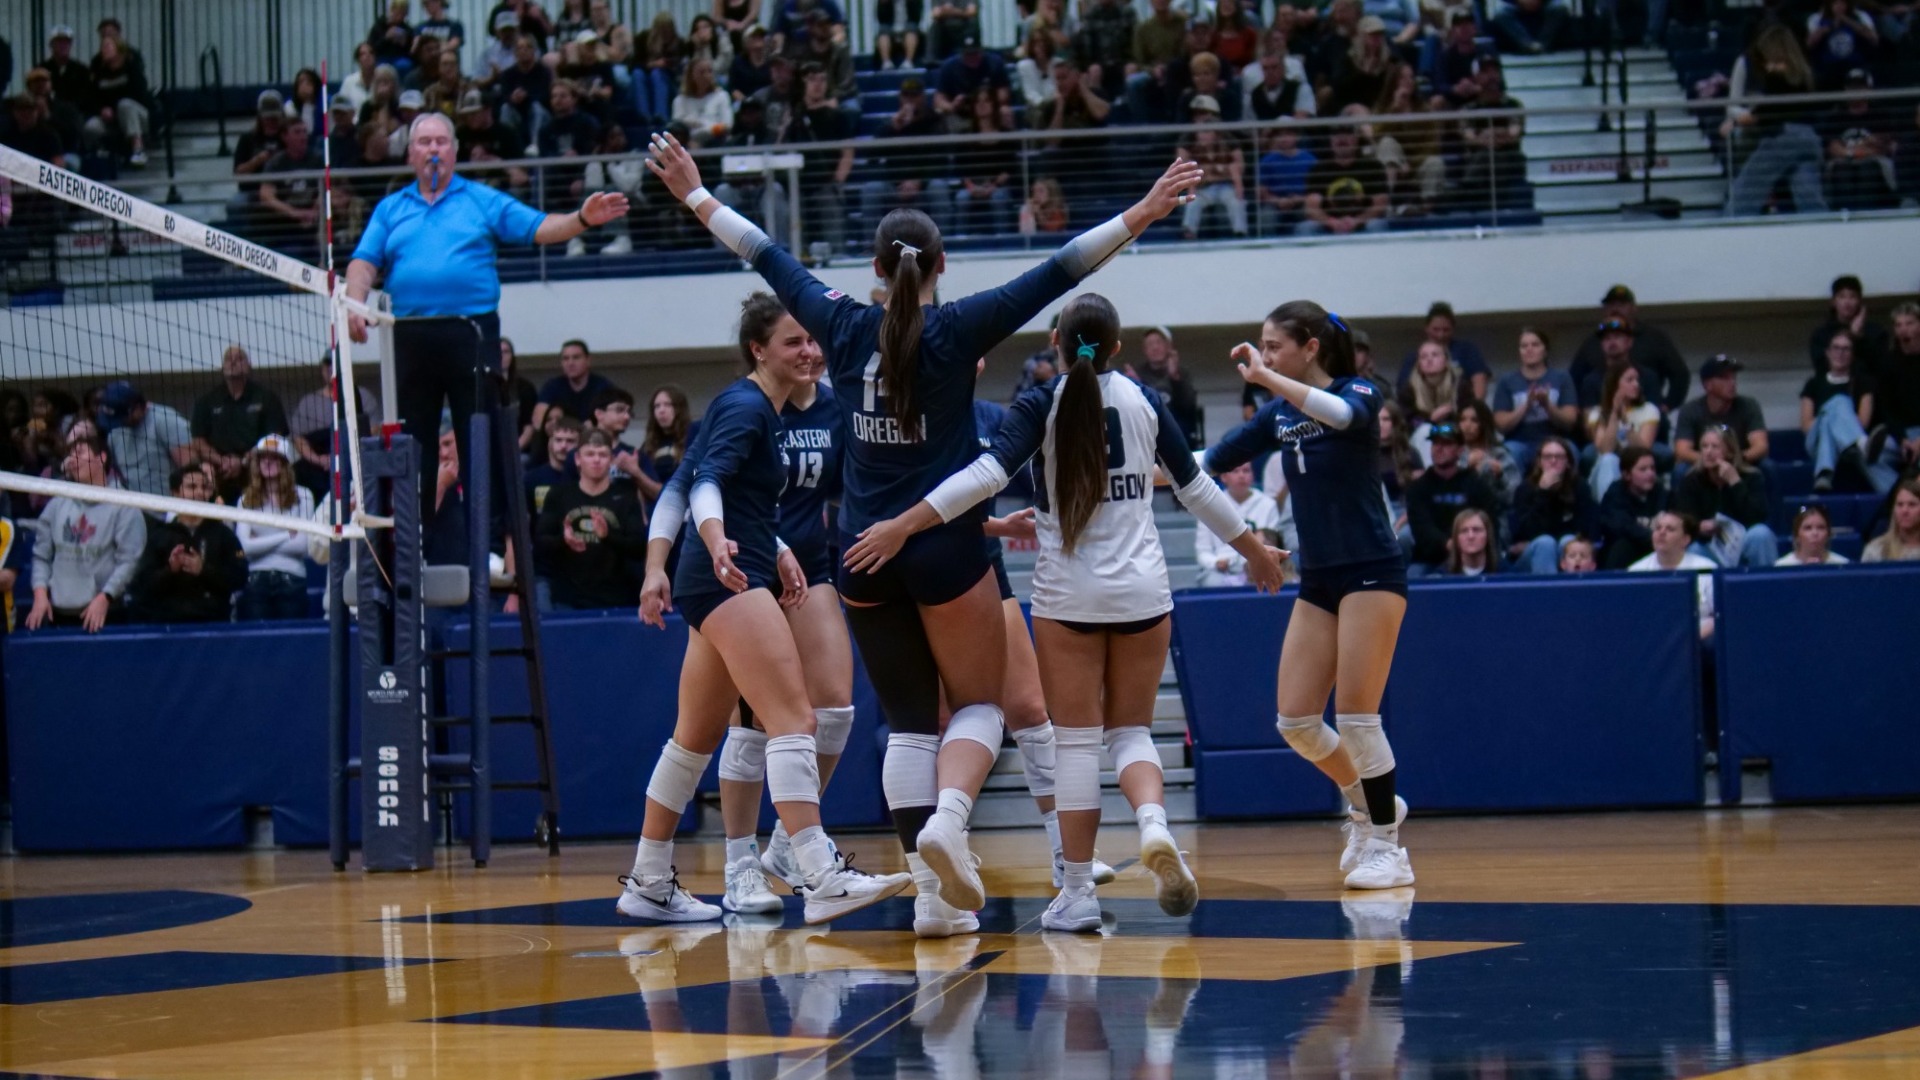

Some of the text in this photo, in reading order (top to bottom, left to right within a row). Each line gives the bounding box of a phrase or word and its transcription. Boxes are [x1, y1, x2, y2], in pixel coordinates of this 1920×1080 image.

[39, 165, 133, 218] EASTERN OREGON
[205, 230, 278, 273] EASTERN OREGON
[796, 451, 824, 489] 13
